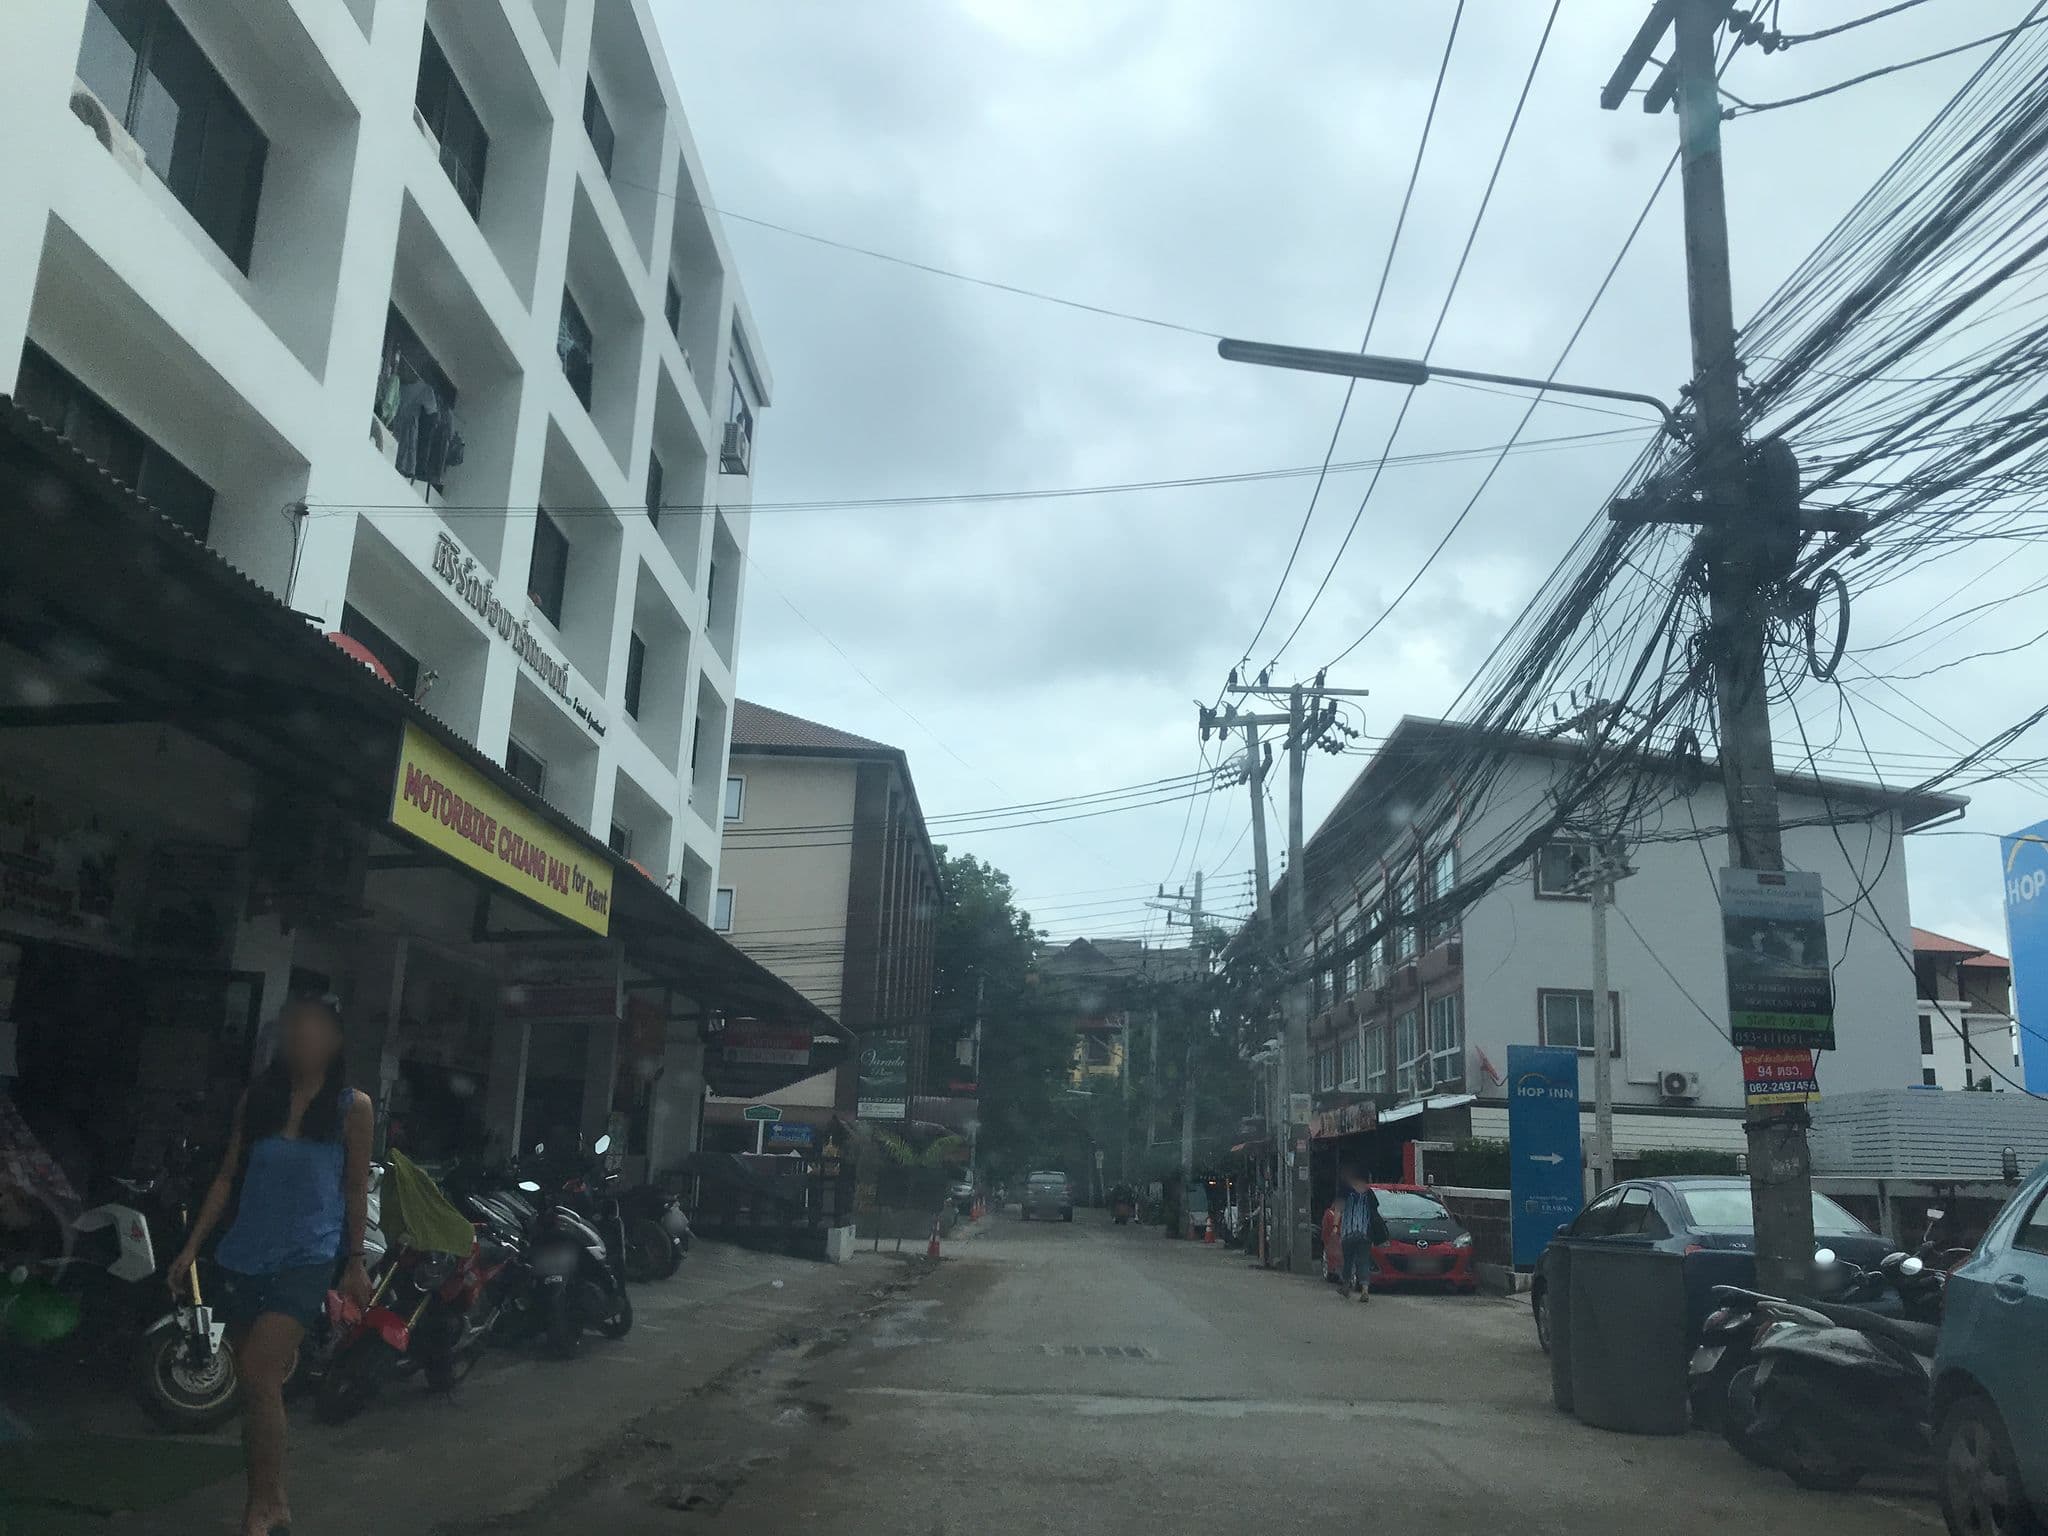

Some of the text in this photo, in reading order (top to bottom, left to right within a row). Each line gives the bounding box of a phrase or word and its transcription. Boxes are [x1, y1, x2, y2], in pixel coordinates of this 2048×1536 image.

[403, 762, 609, 915] MOTORBIKE CHIANG MAI for Rent
[2007, 869, 2046, 905] HOP
[1758, 1065, 1773, 1077] 94
[1517, 1086, 1574, 1099] HOP INN
